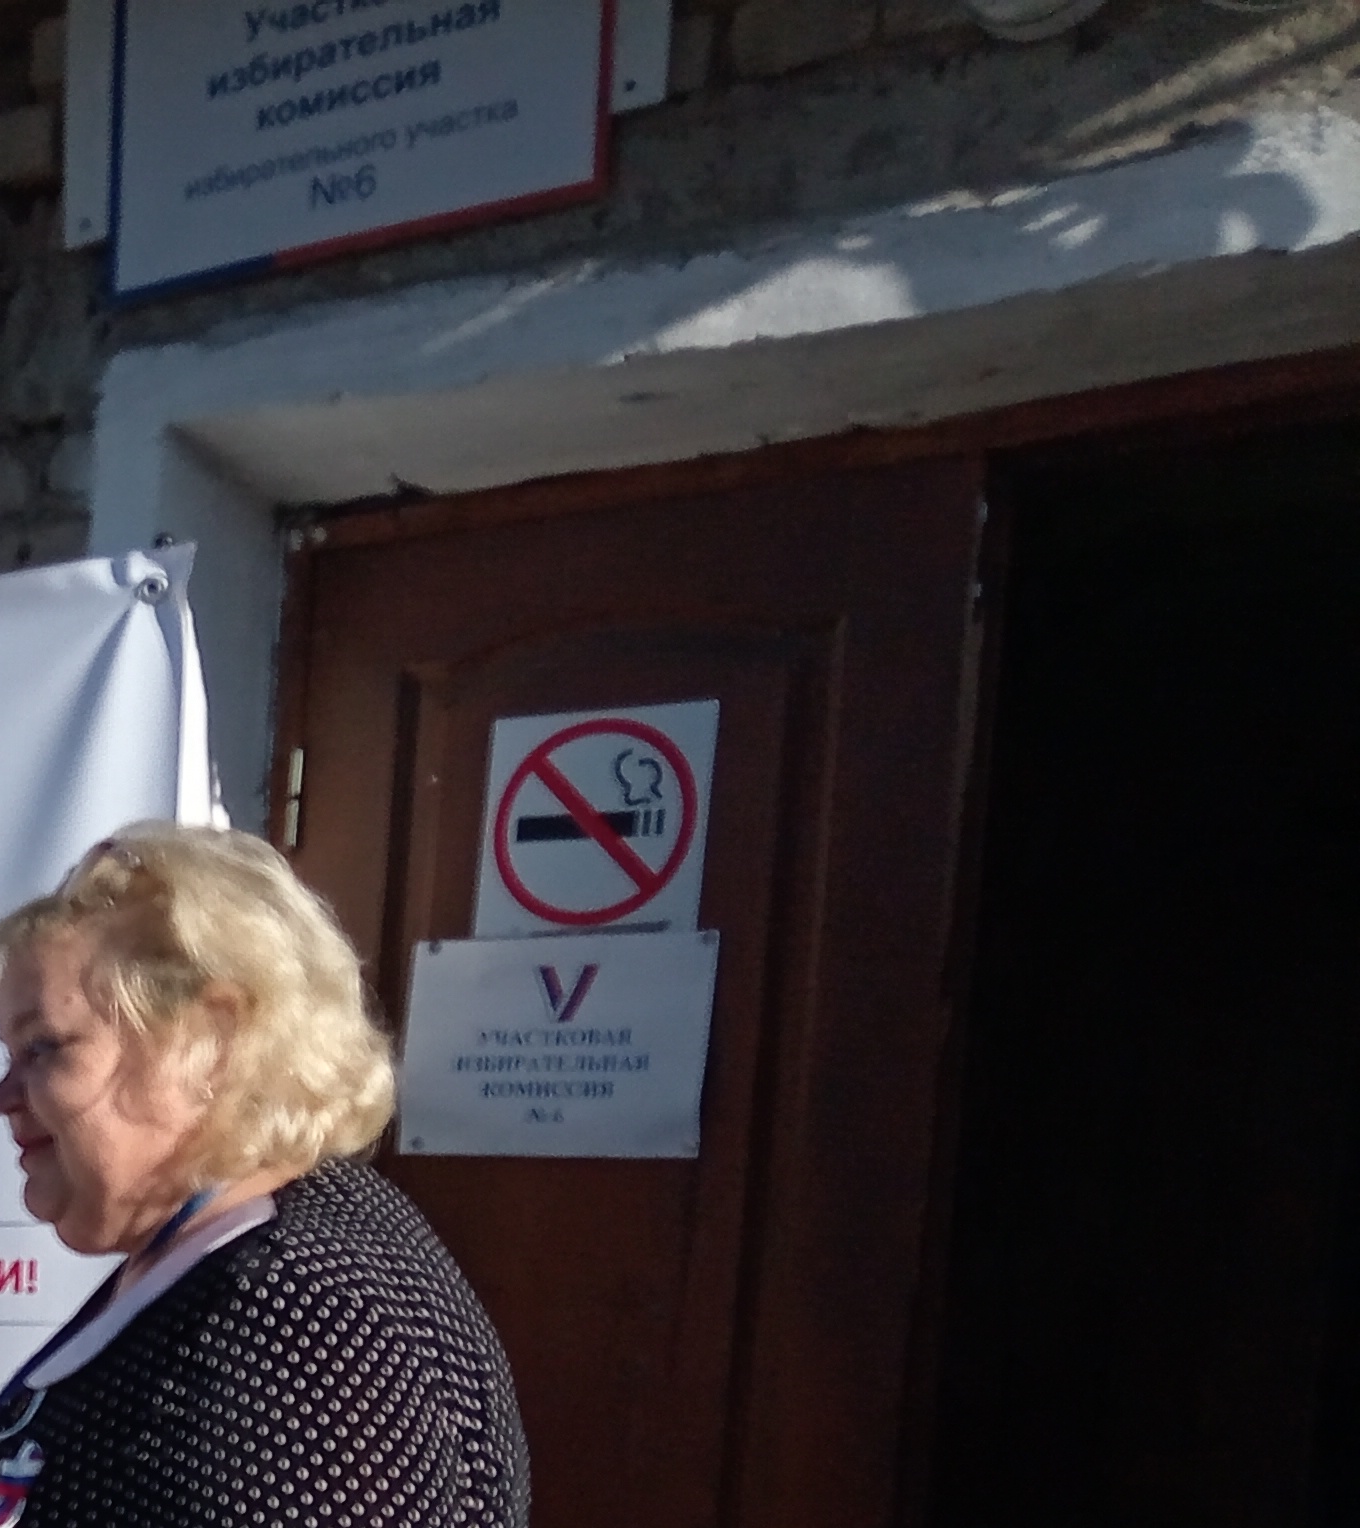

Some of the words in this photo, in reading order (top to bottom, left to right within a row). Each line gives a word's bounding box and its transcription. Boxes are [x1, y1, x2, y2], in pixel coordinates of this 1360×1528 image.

[245, 0, 385, 43] Участ
[207, 0, 501, 99] избирательная
[255, 59, 442, 131] комиссия
[405, 98, 519, 150] участка
[307, 163, 378, 211] №6
